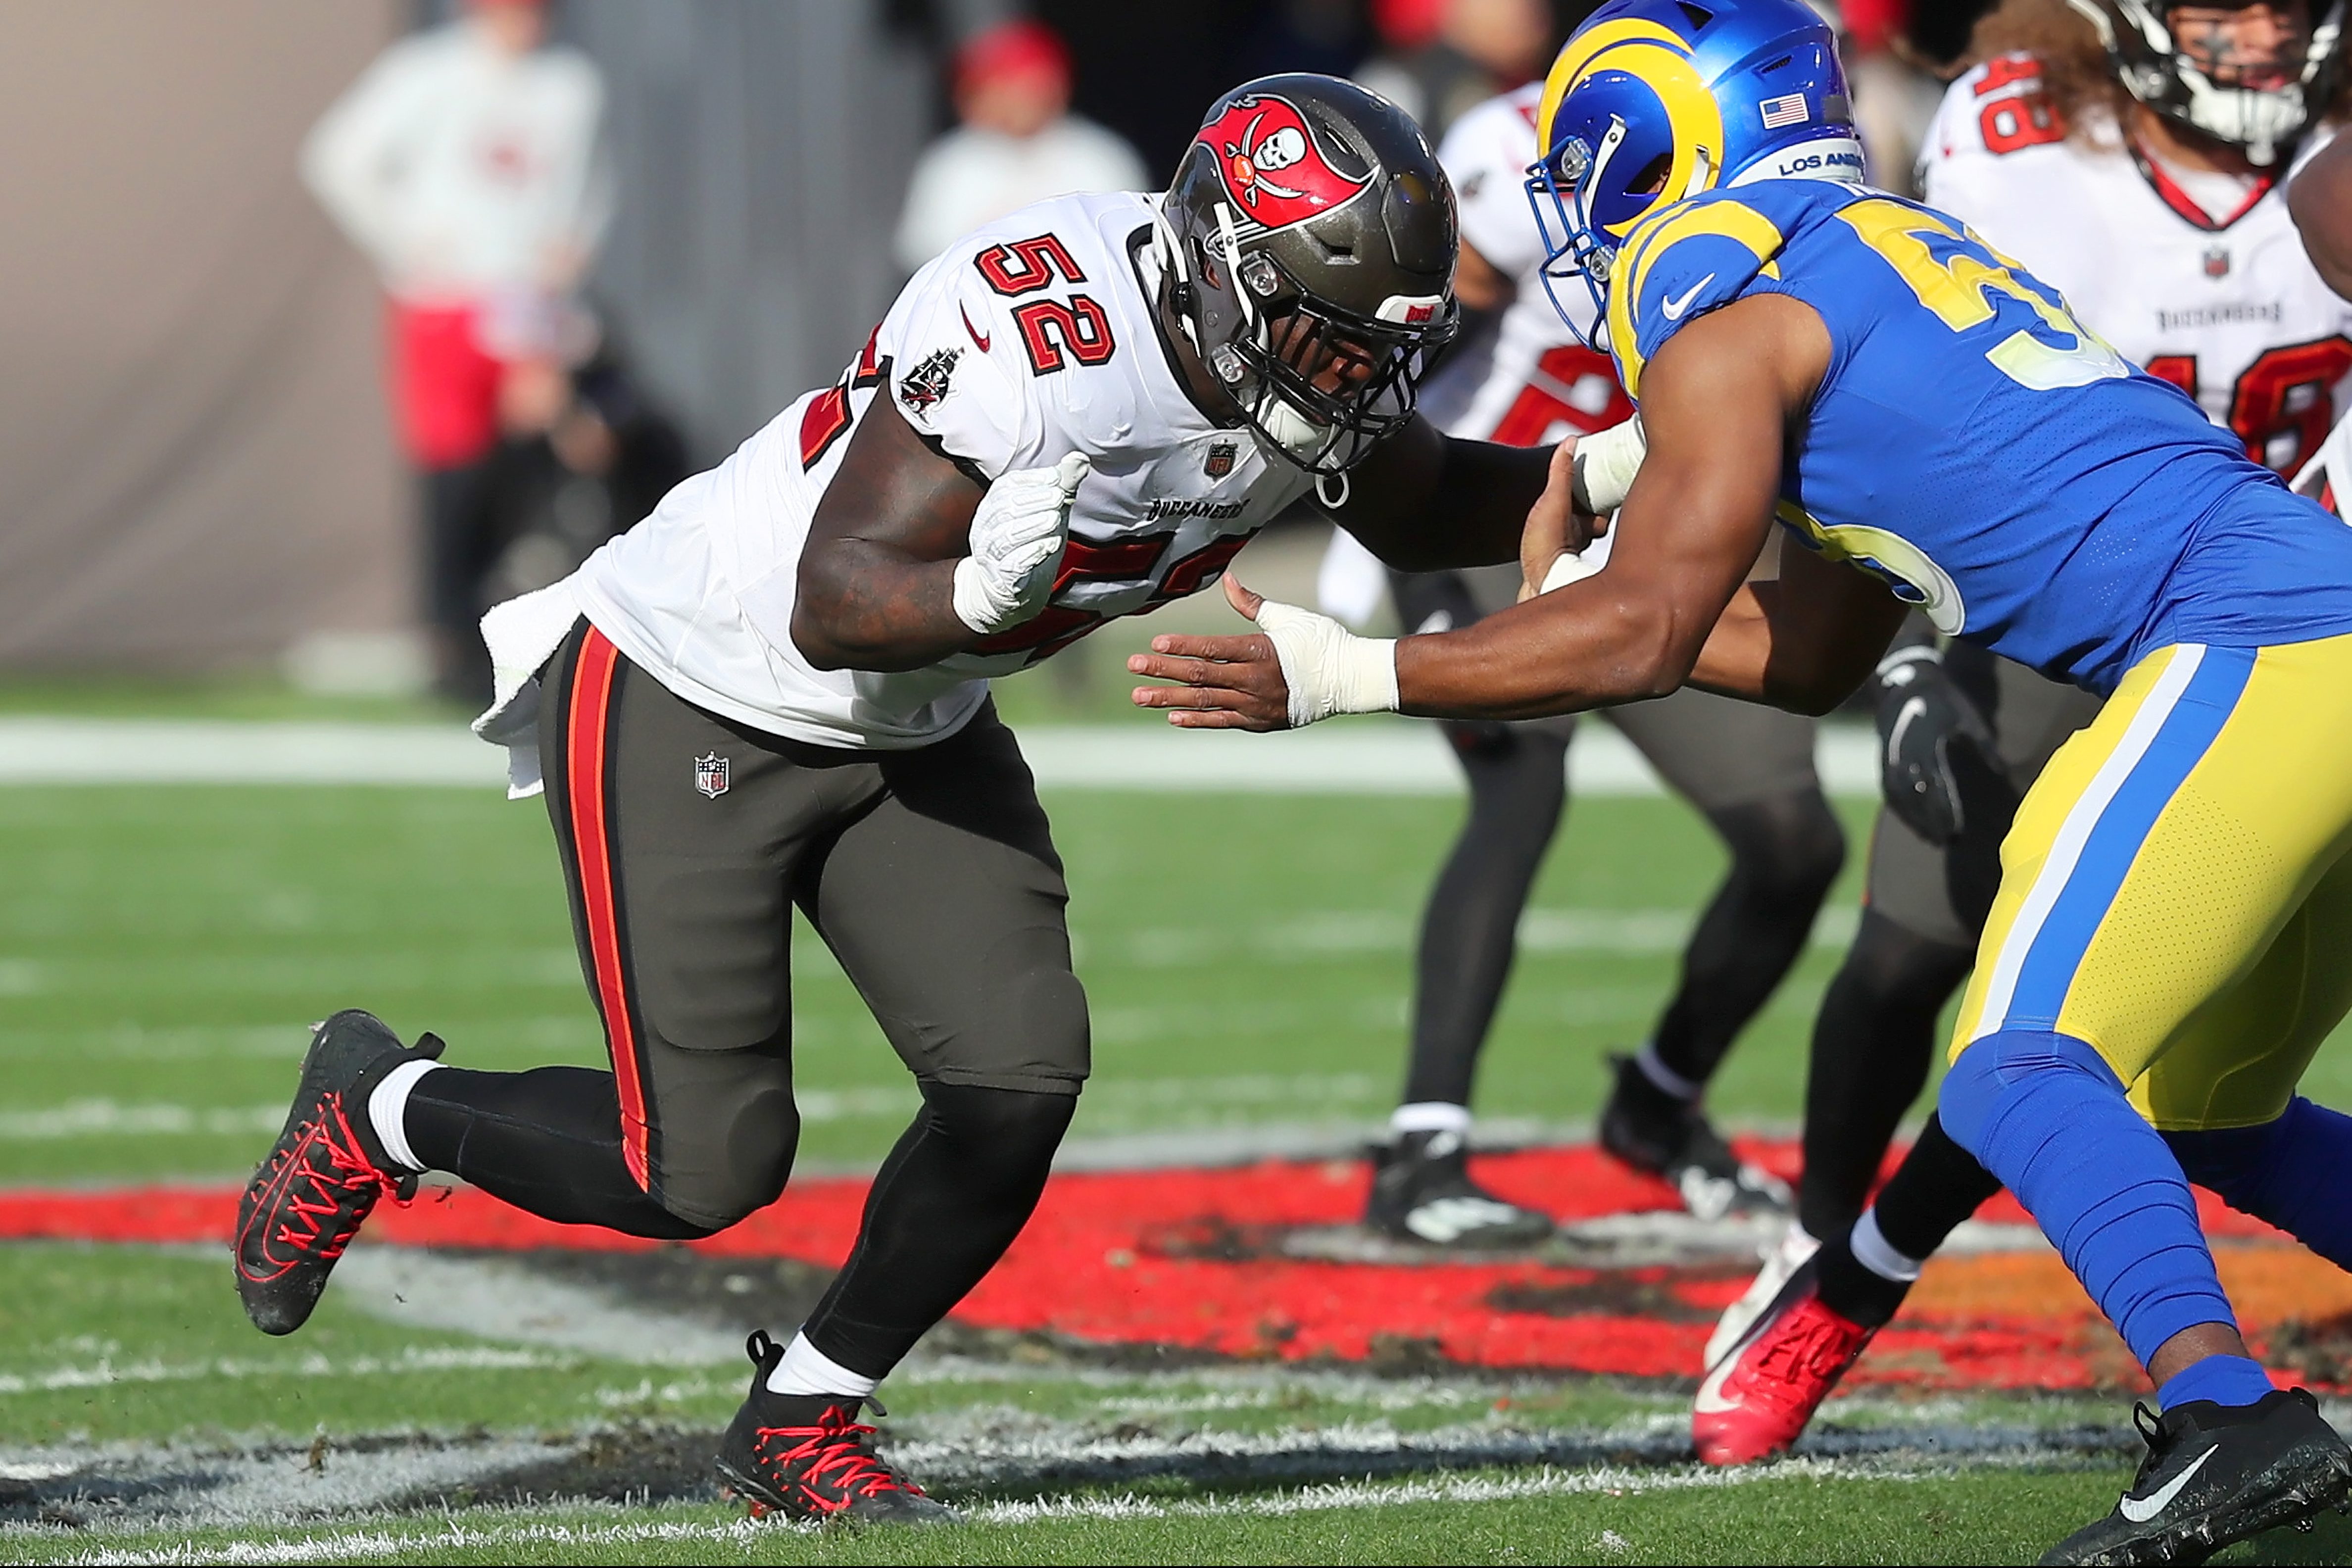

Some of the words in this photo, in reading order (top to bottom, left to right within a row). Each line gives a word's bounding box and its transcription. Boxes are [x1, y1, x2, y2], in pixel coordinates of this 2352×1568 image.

[1779, 155, 1822, 177] LOS
[973, 232, 1116, 378] 52
[1833, 198, 2130, 392] 5
[700, 773, 725, 789] NFL
